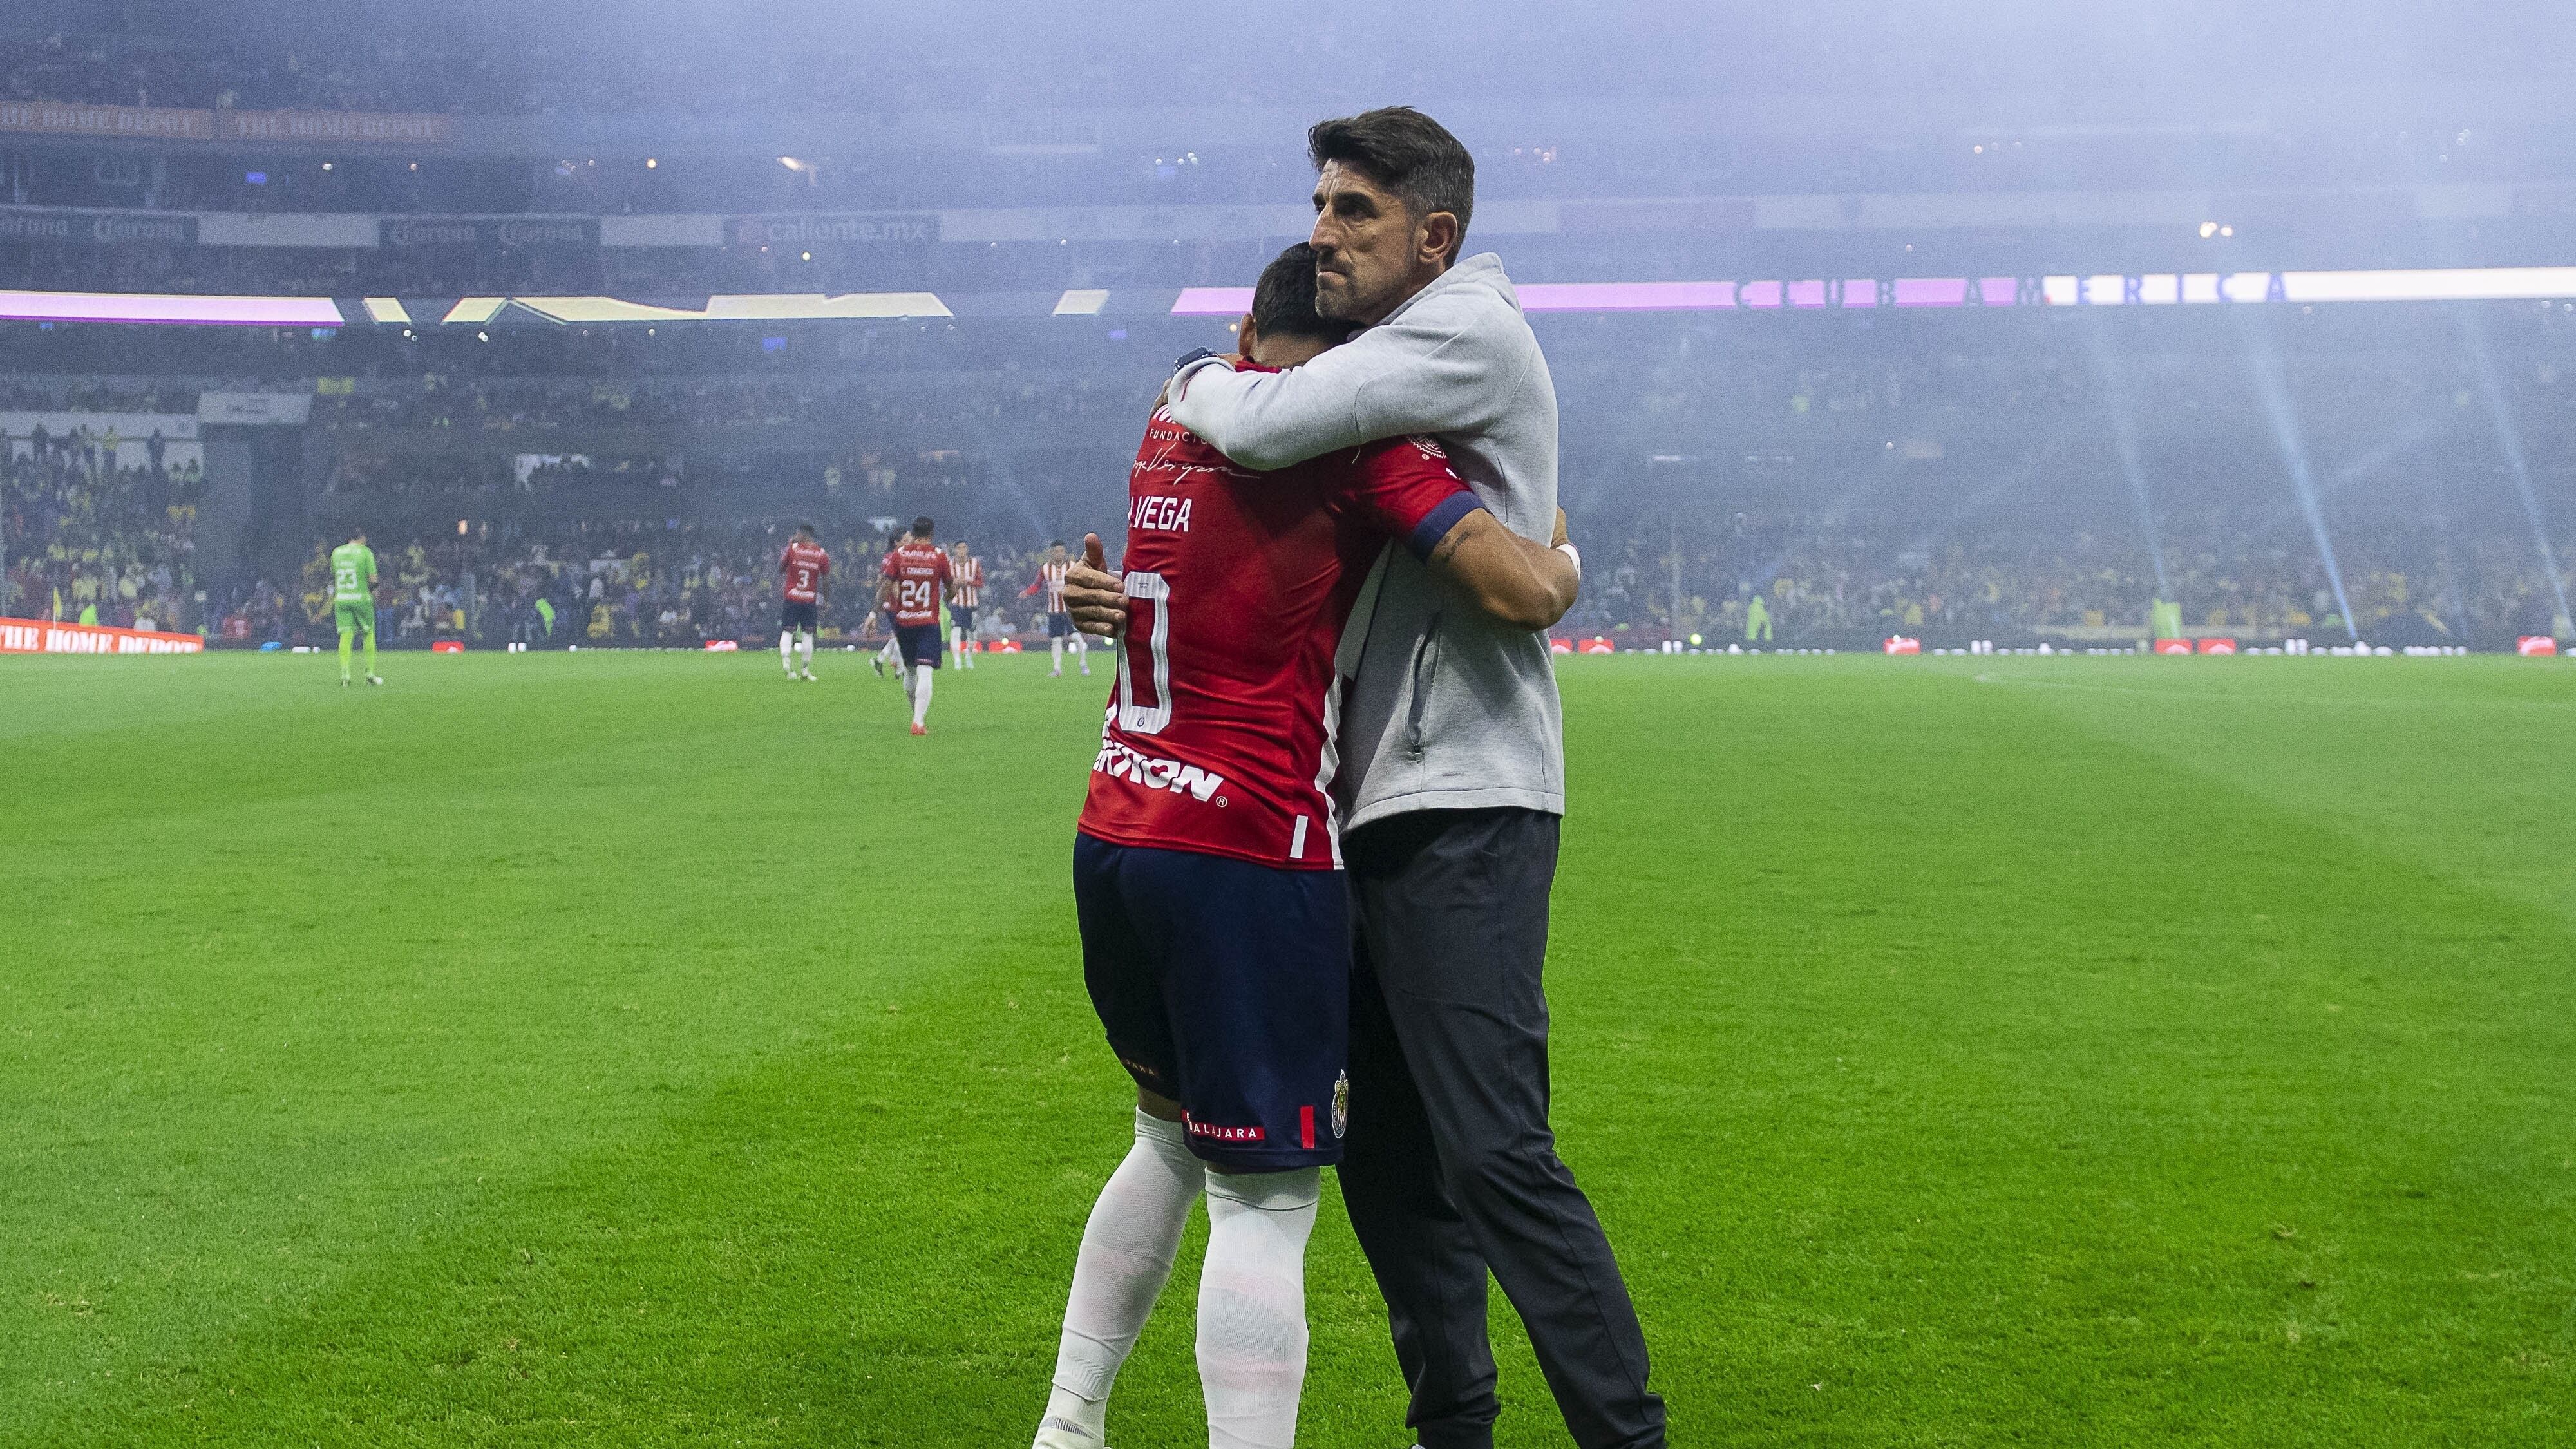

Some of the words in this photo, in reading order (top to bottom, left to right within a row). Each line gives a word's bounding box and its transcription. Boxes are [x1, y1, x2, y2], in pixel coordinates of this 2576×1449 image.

[1, 106, 33, 126] HE
[1, 217, 68, 235] orona
[1734, 278, 1896, 308] CLUB
[336, 568, 357, 589] 23
[796, 569, 810, 589] 3
[901, 579, 931, 609] 24
[44, 629, 113, 652] HOME
[1114, 571, 1172, 735] 0
